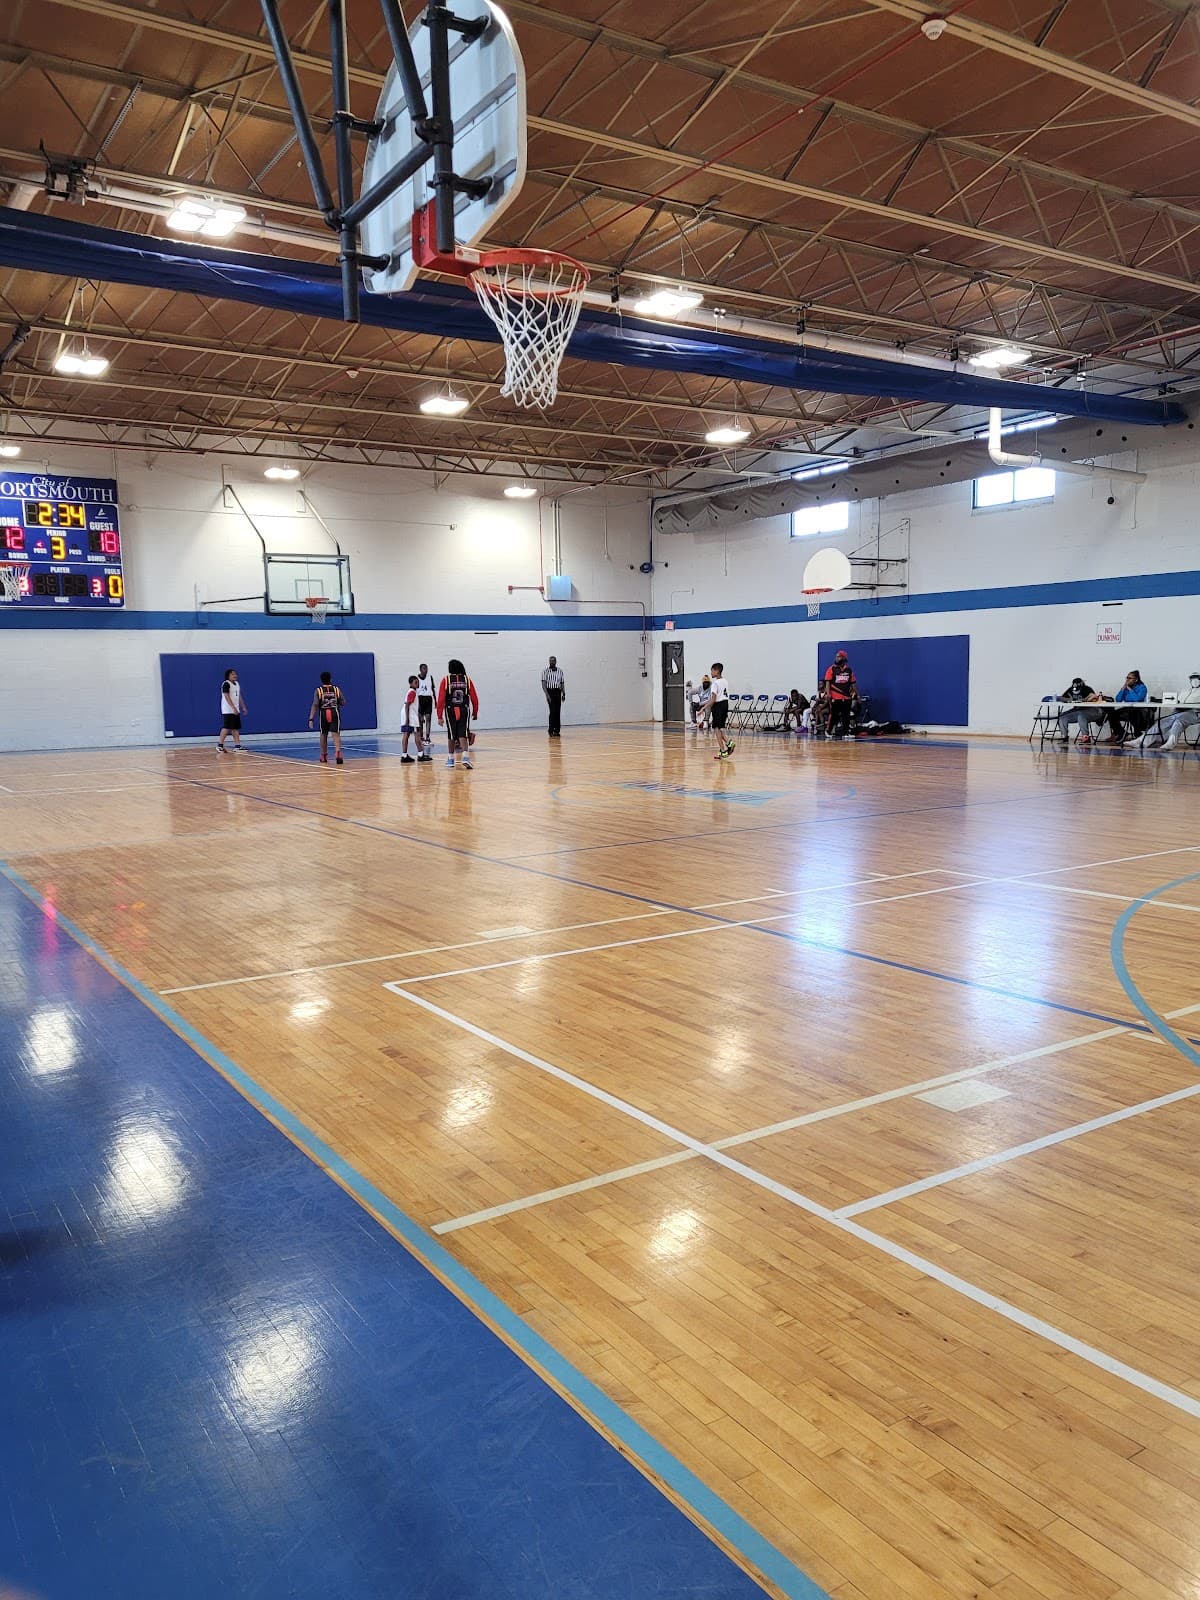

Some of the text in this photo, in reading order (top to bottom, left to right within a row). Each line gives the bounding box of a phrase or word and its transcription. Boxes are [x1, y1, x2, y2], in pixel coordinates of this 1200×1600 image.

[0, 481, 113, 502] ORTSMOUTH
[32, 476, 71, 487] City of
[0, 517, 19, 527] OME
[39, 502, 84, 526] 2:34
[89, 521, 113, 531] GUEST
[5, 527, 24, 549] 12
[51, 536, 65, 559] 3
[100, 531, 118, 553] 18
[50, 566, 71, 574] PLAYER
[92, 578, 102, 592] 3
[108, 575, 122, 597] 0
